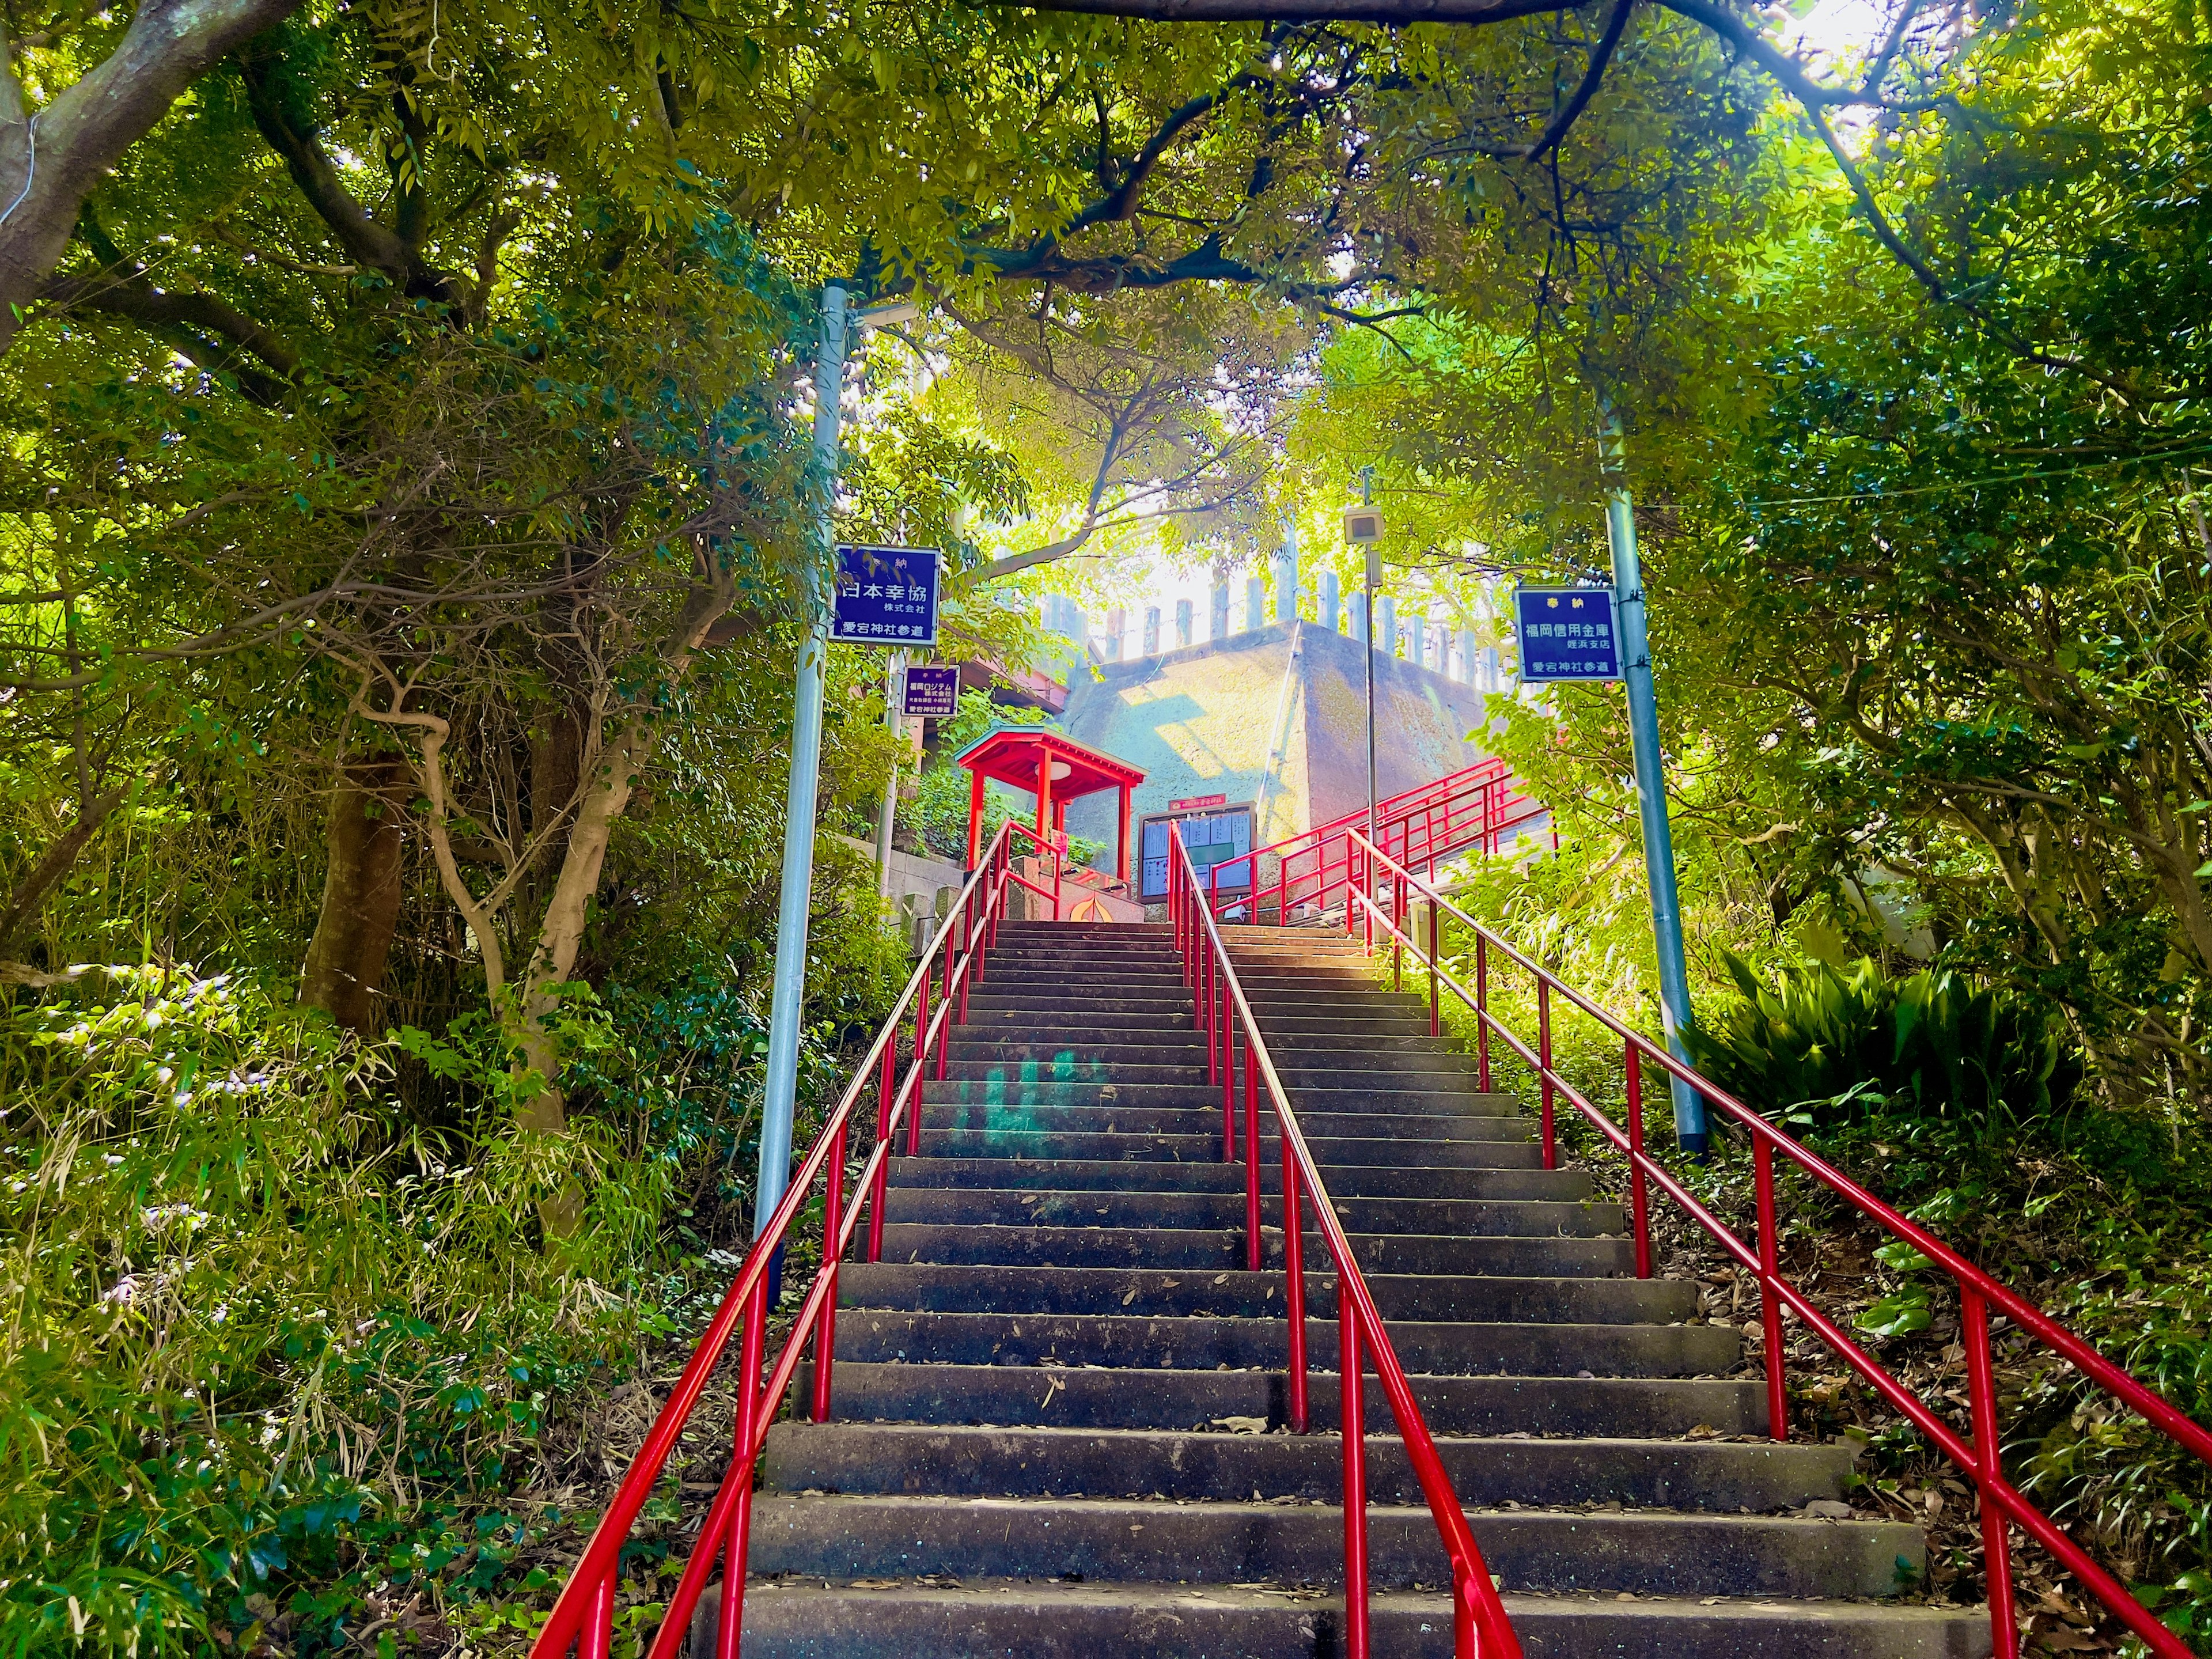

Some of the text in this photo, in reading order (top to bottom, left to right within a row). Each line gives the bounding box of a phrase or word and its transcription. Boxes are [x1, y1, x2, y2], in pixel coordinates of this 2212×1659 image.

[843, 582, 926, 601] 日本幸協
[884, 603, 925, 613] 株式会社
[1547, 597, 1584, 608] 奉納
[843, 622, 923, 637] 愛宕神社参道
[1527, 624, 1608, 637] 福岡信用金庫
[1567, 640, 1610, 649] 姪浜支店
[1533, 662, 1609, 672] 愛宕神社参道
